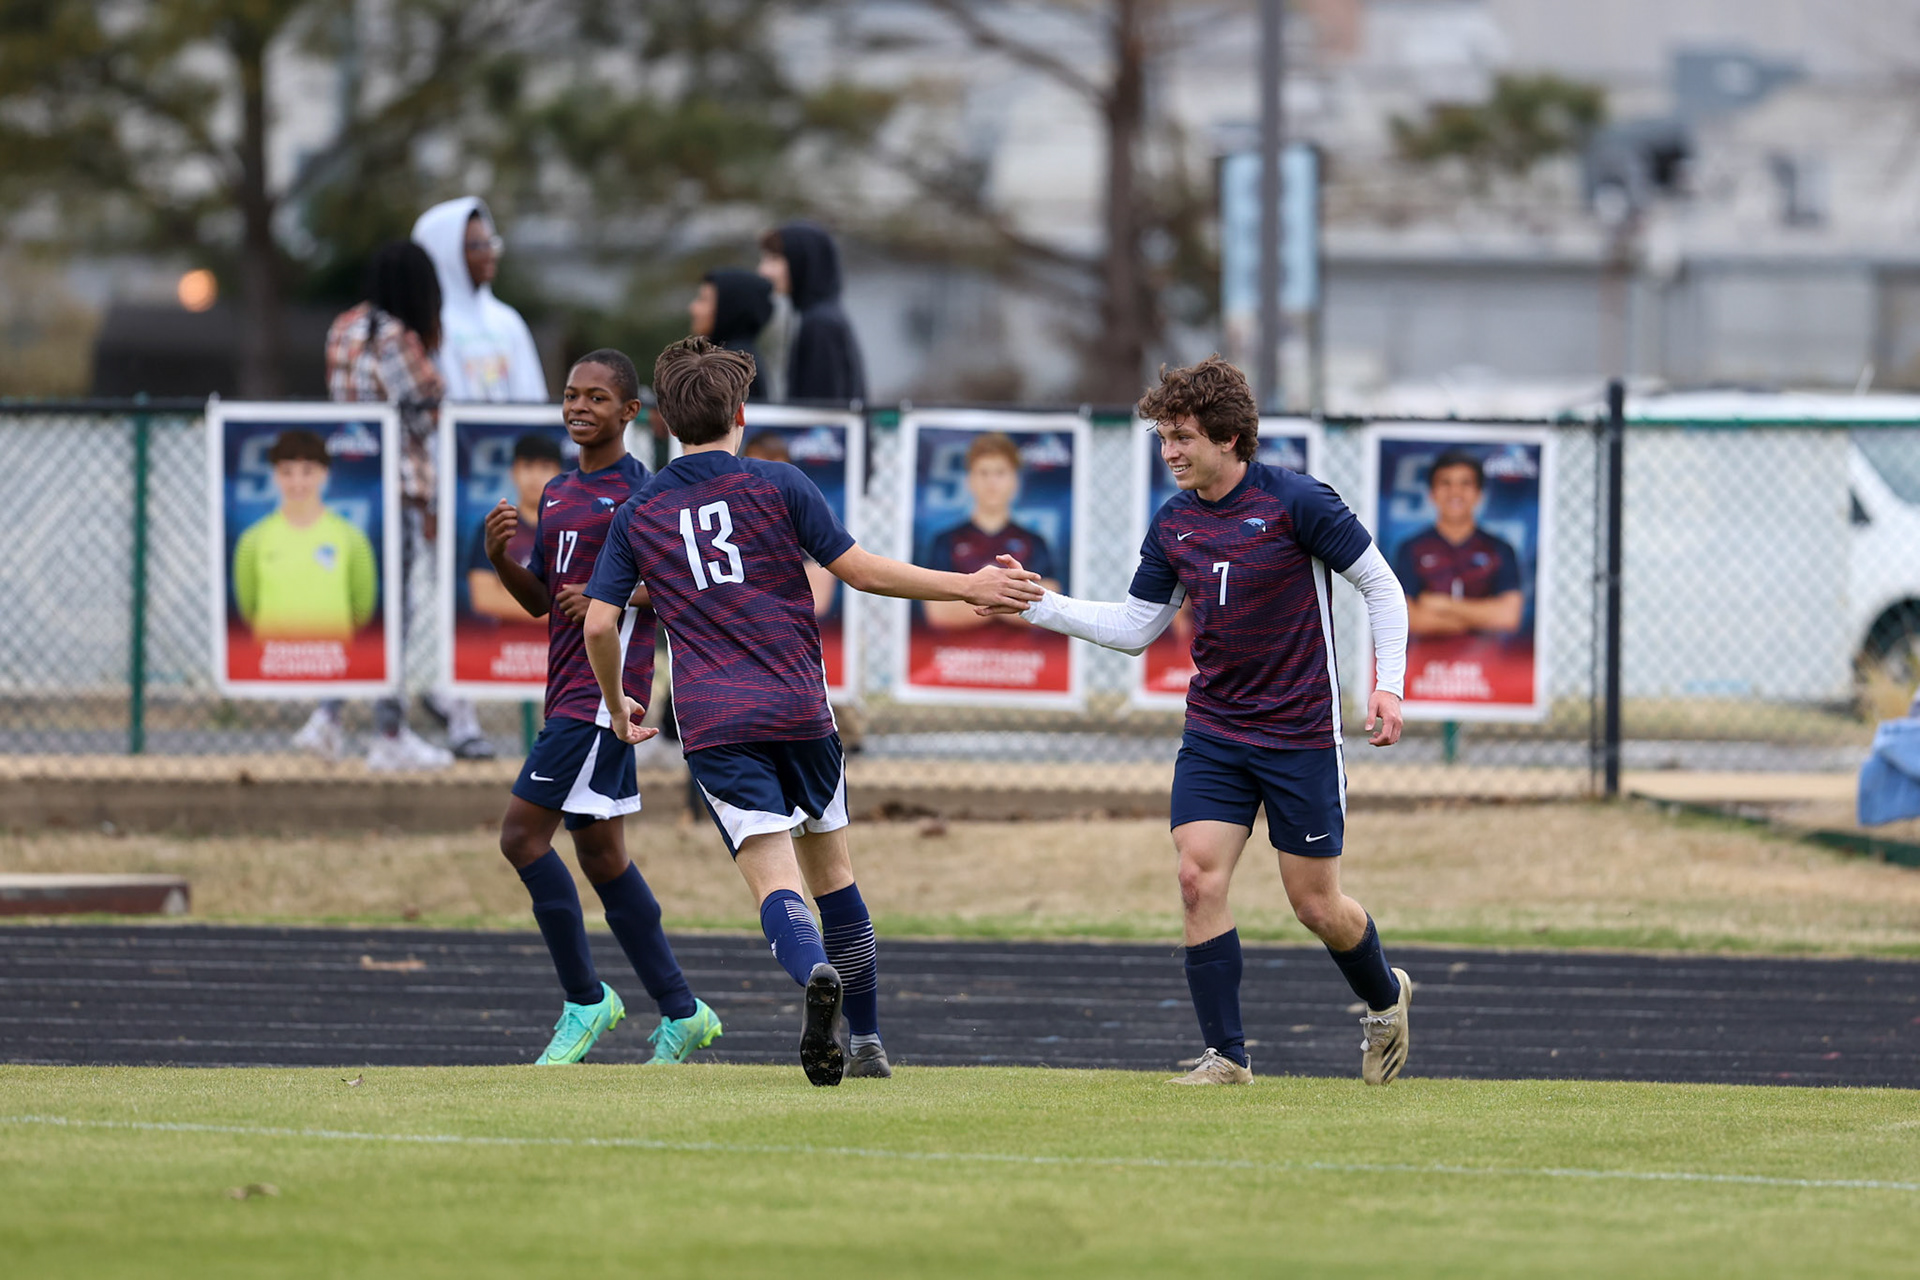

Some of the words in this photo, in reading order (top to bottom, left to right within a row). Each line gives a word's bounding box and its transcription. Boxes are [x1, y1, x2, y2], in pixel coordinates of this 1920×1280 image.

[556, 530, 578, 573] 17
[680, 500, 745, 591] 13
[1212, 561, 1230, 605] 7
